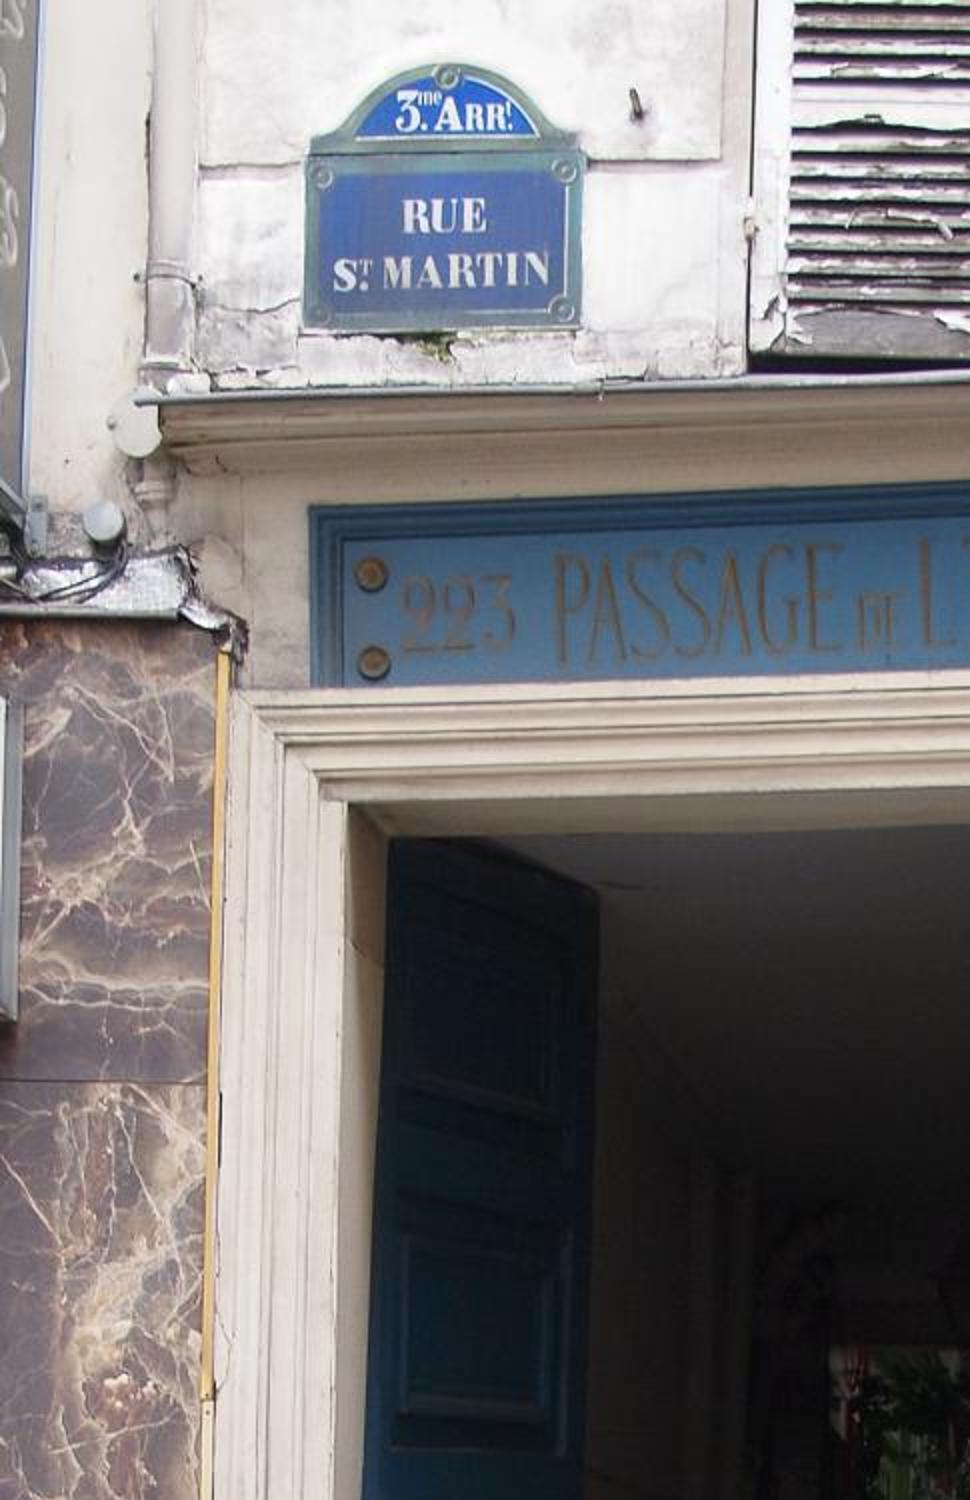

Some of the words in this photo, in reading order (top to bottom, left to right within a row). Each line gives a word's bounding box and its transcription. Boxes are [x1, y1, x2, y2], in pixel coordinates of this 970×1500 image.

[402, 198, 487, 235] RUE
[383, 251, 549, 290] MARTIN
[402, 574, 516, 652] 223
[553, 541, 846, 667] PASSAGE
